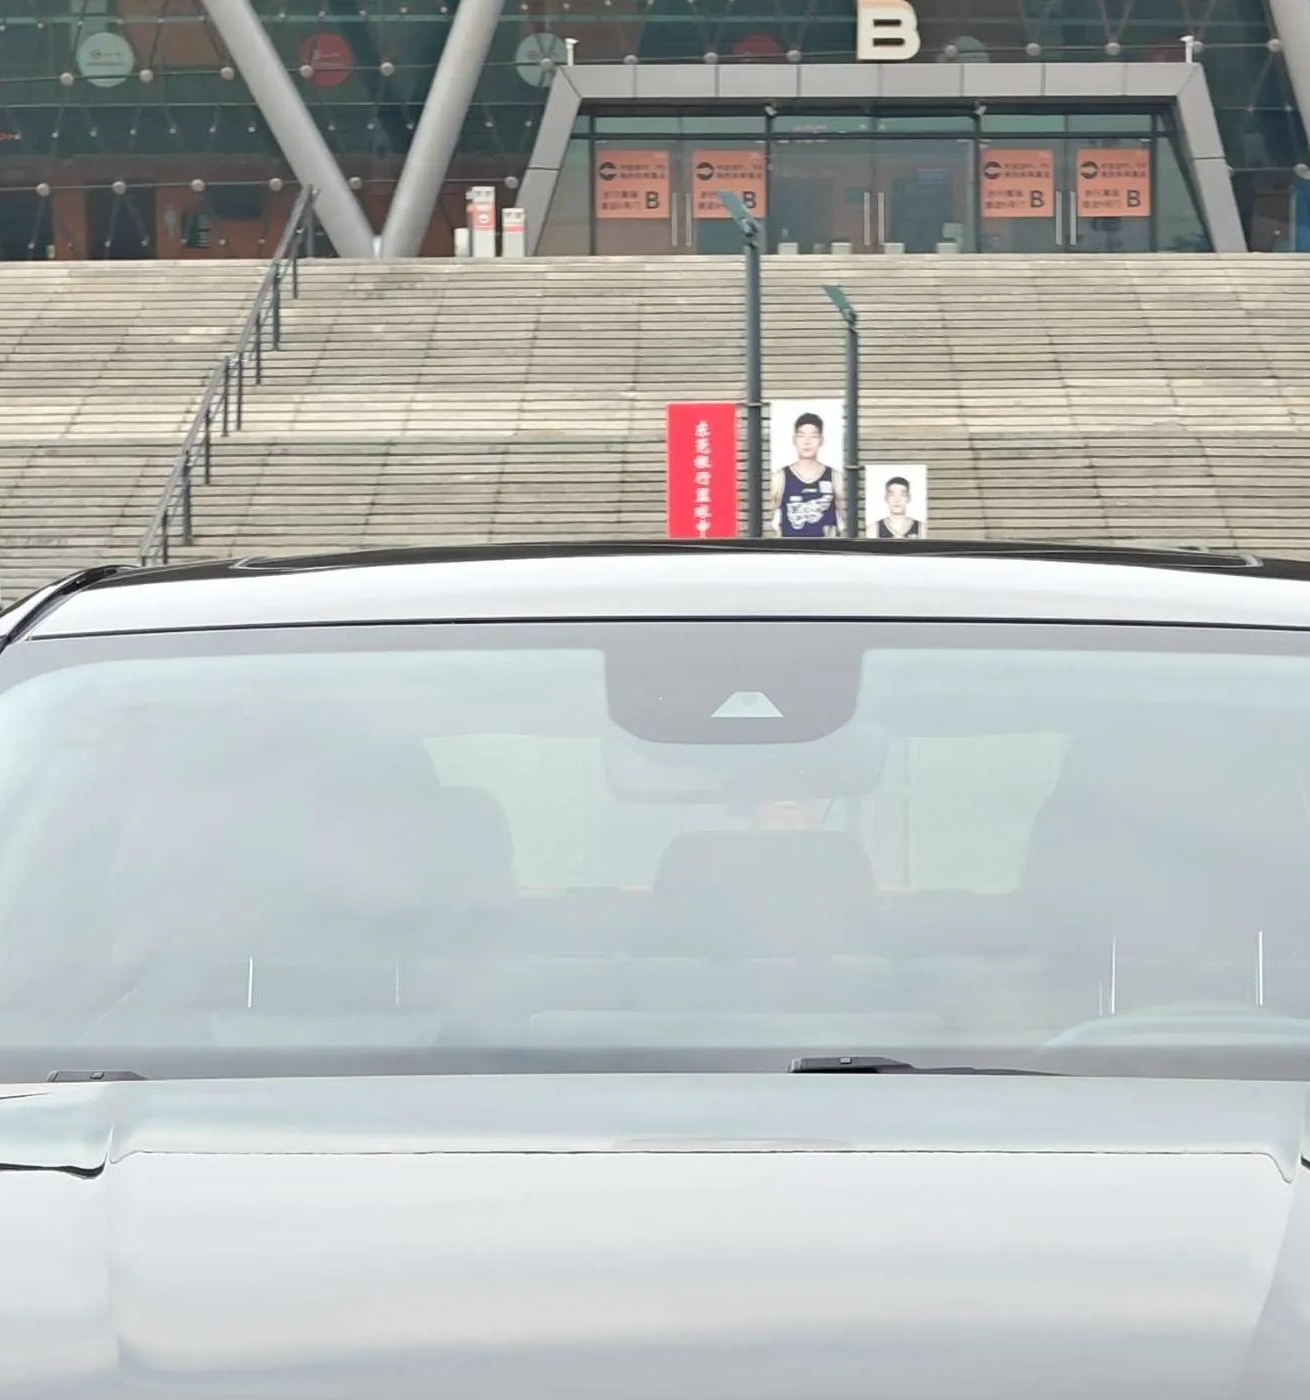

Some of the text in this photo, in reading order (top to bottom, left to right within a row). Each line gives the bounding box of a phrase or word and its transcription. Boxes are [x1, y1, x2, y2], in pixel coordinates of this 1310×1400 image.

[856, 0, 921, 61] B
[646, 190, 660, 210] B
[743, 190, 757, 210] B
[1030, 189, 1045, 209] B
[1127, 189, 1141, 208] B
